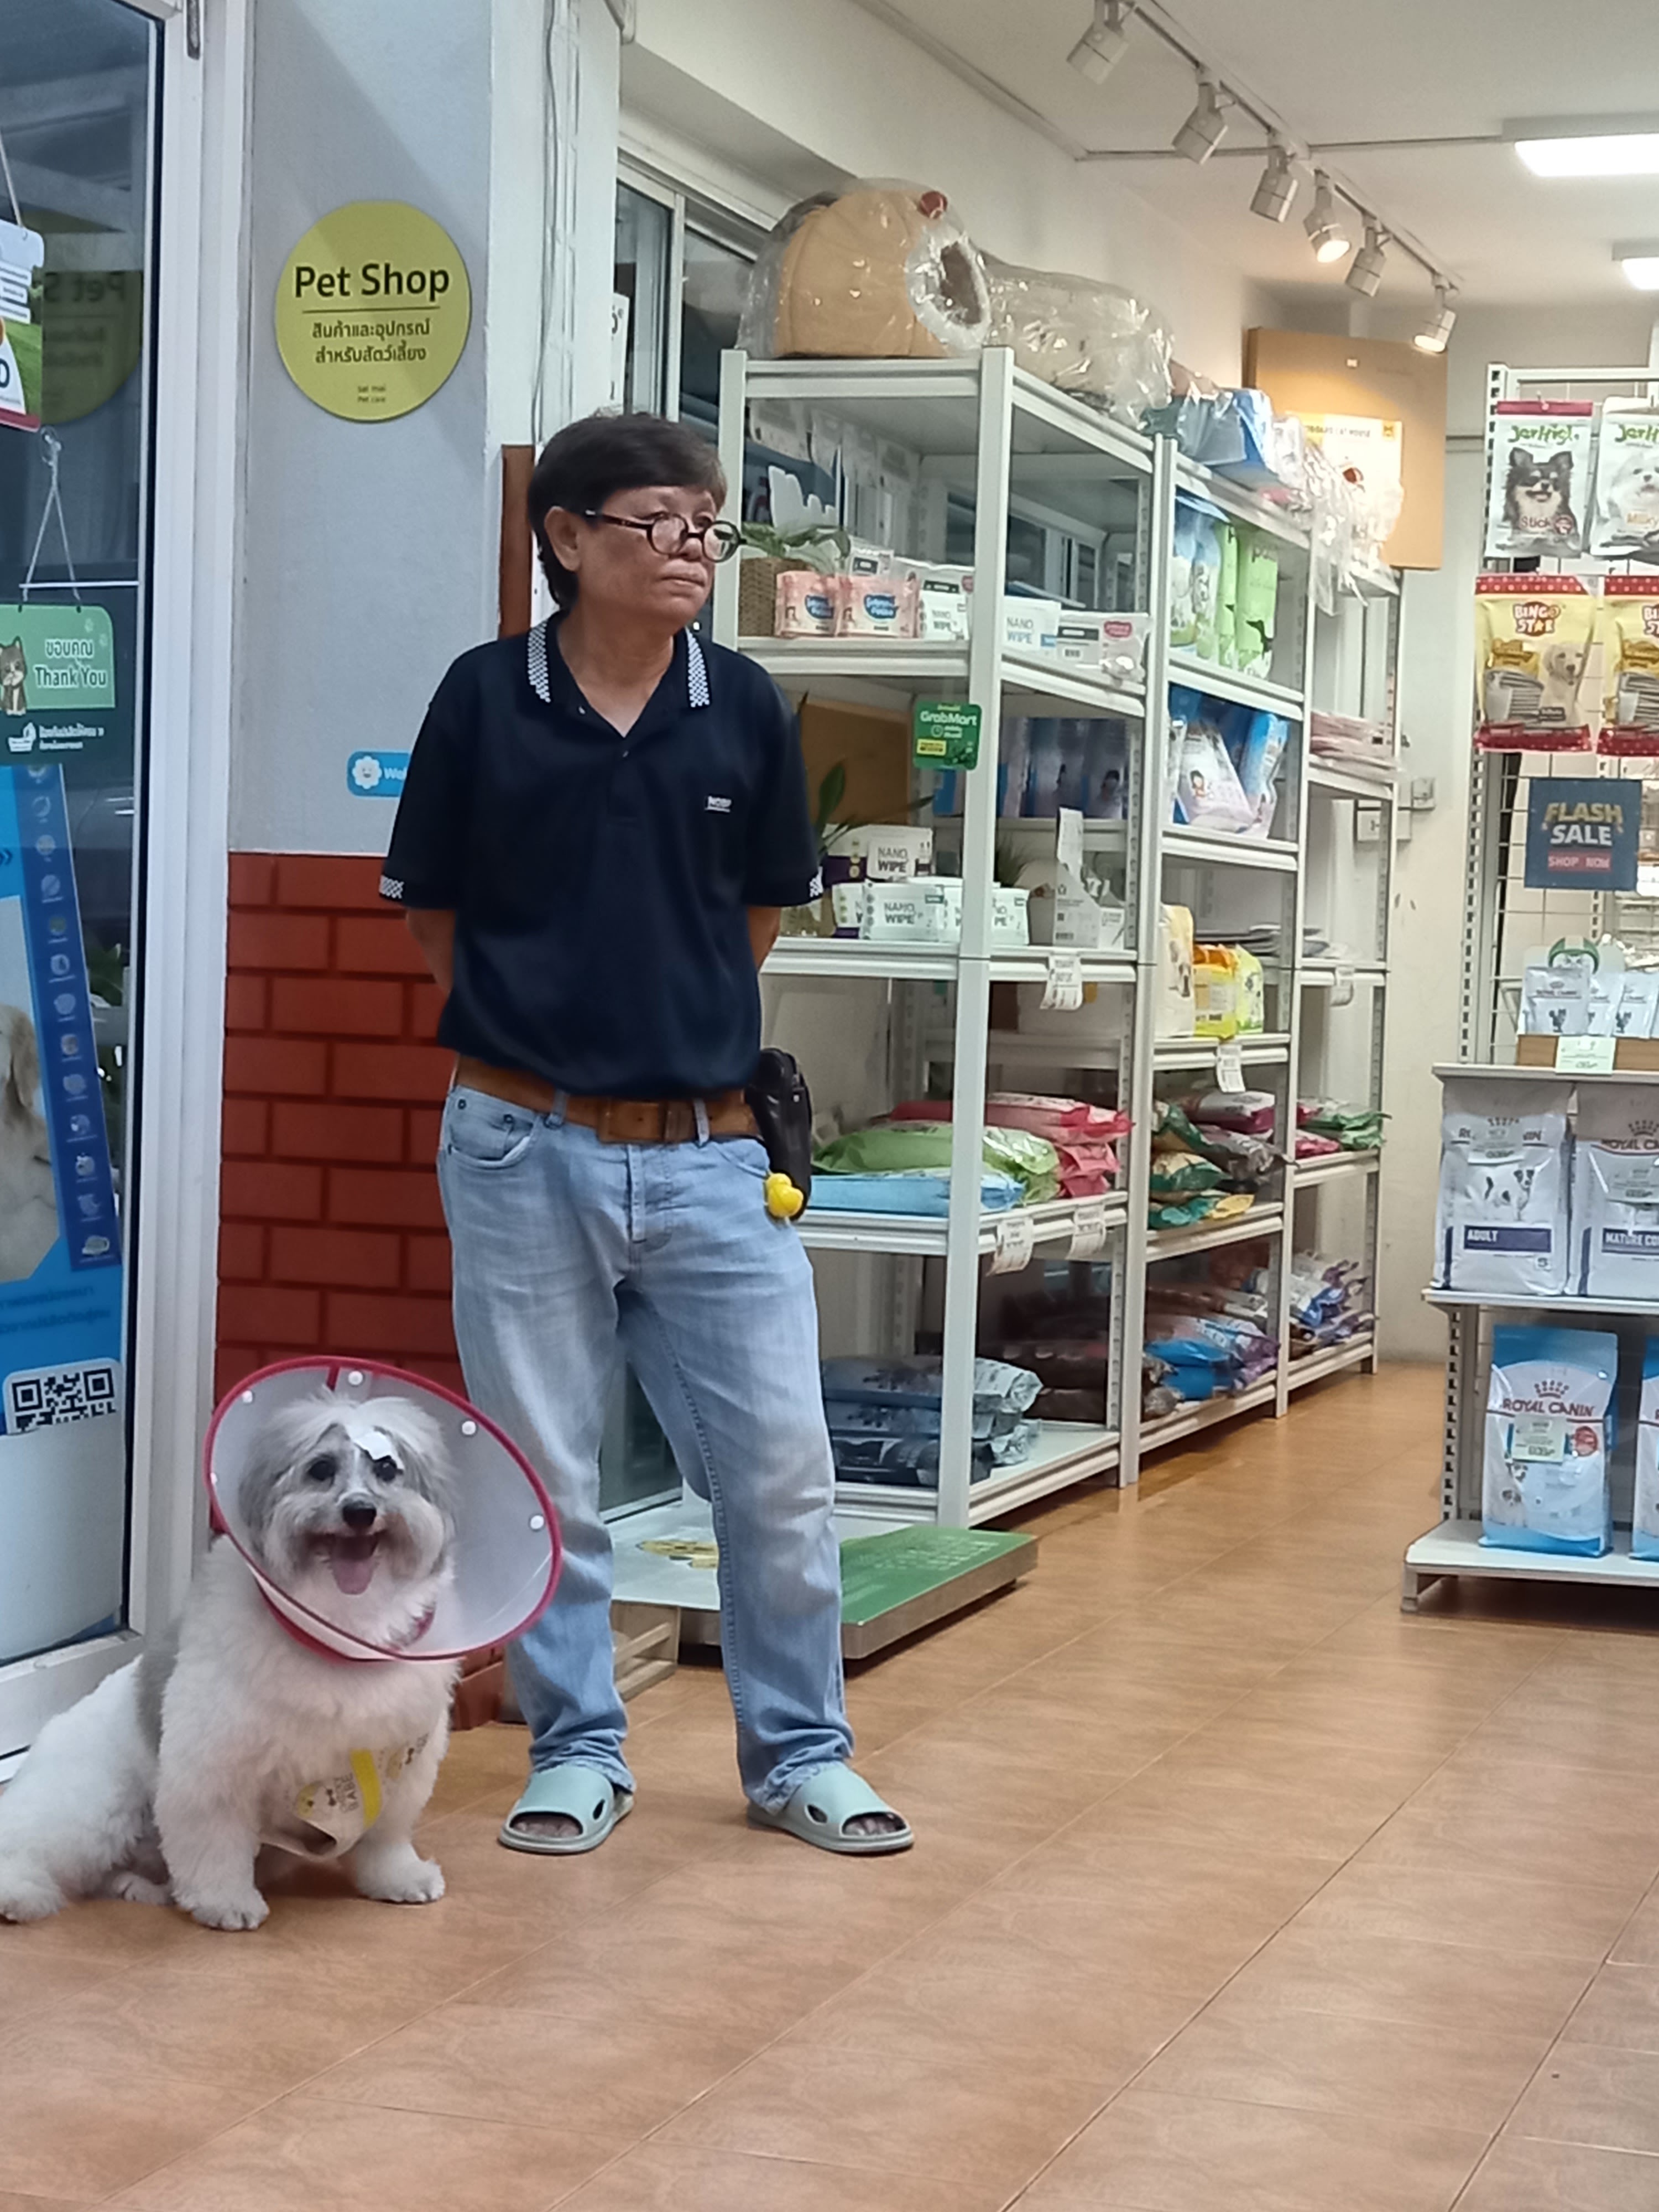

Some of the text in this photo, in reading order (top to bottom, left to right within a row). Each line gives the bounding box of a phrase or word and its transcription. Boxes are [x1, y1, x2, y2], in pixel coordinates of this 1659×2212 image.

[295, 262, 450, 302] Pet Shop
[312, 317, 430, 341] สินค้าและอุปกรณ์
[315, 339, 427, 363] สำหรับสัตว์เลี้ยง
[1514, 604, 1560, 619] BINGO
[1006, 617, 1034, 629] NANO
[1006, 632, 1033, 644] WIPE
[46, 640, 93, 656] ขอบคณ
[35, 666, 106, 686] Thank You
[920, 710, 977, 726] GrabMart
[1545, 802, 1624, 825] FLASH
[1550, 824, 1613, 846] SALE
[878, 847, 908, 858] NANO
[878, 859, 907, 873] WIPE
[1548, 855, 1610, 868] SHOP NOW
[884, 901, 915, 912] NANO
[885, 914, 915, 925] WIPE
[1467, 1228, 1498, 1241] ADULT
[1502, 1398, 1595, 1417] ROYAL CANIN
